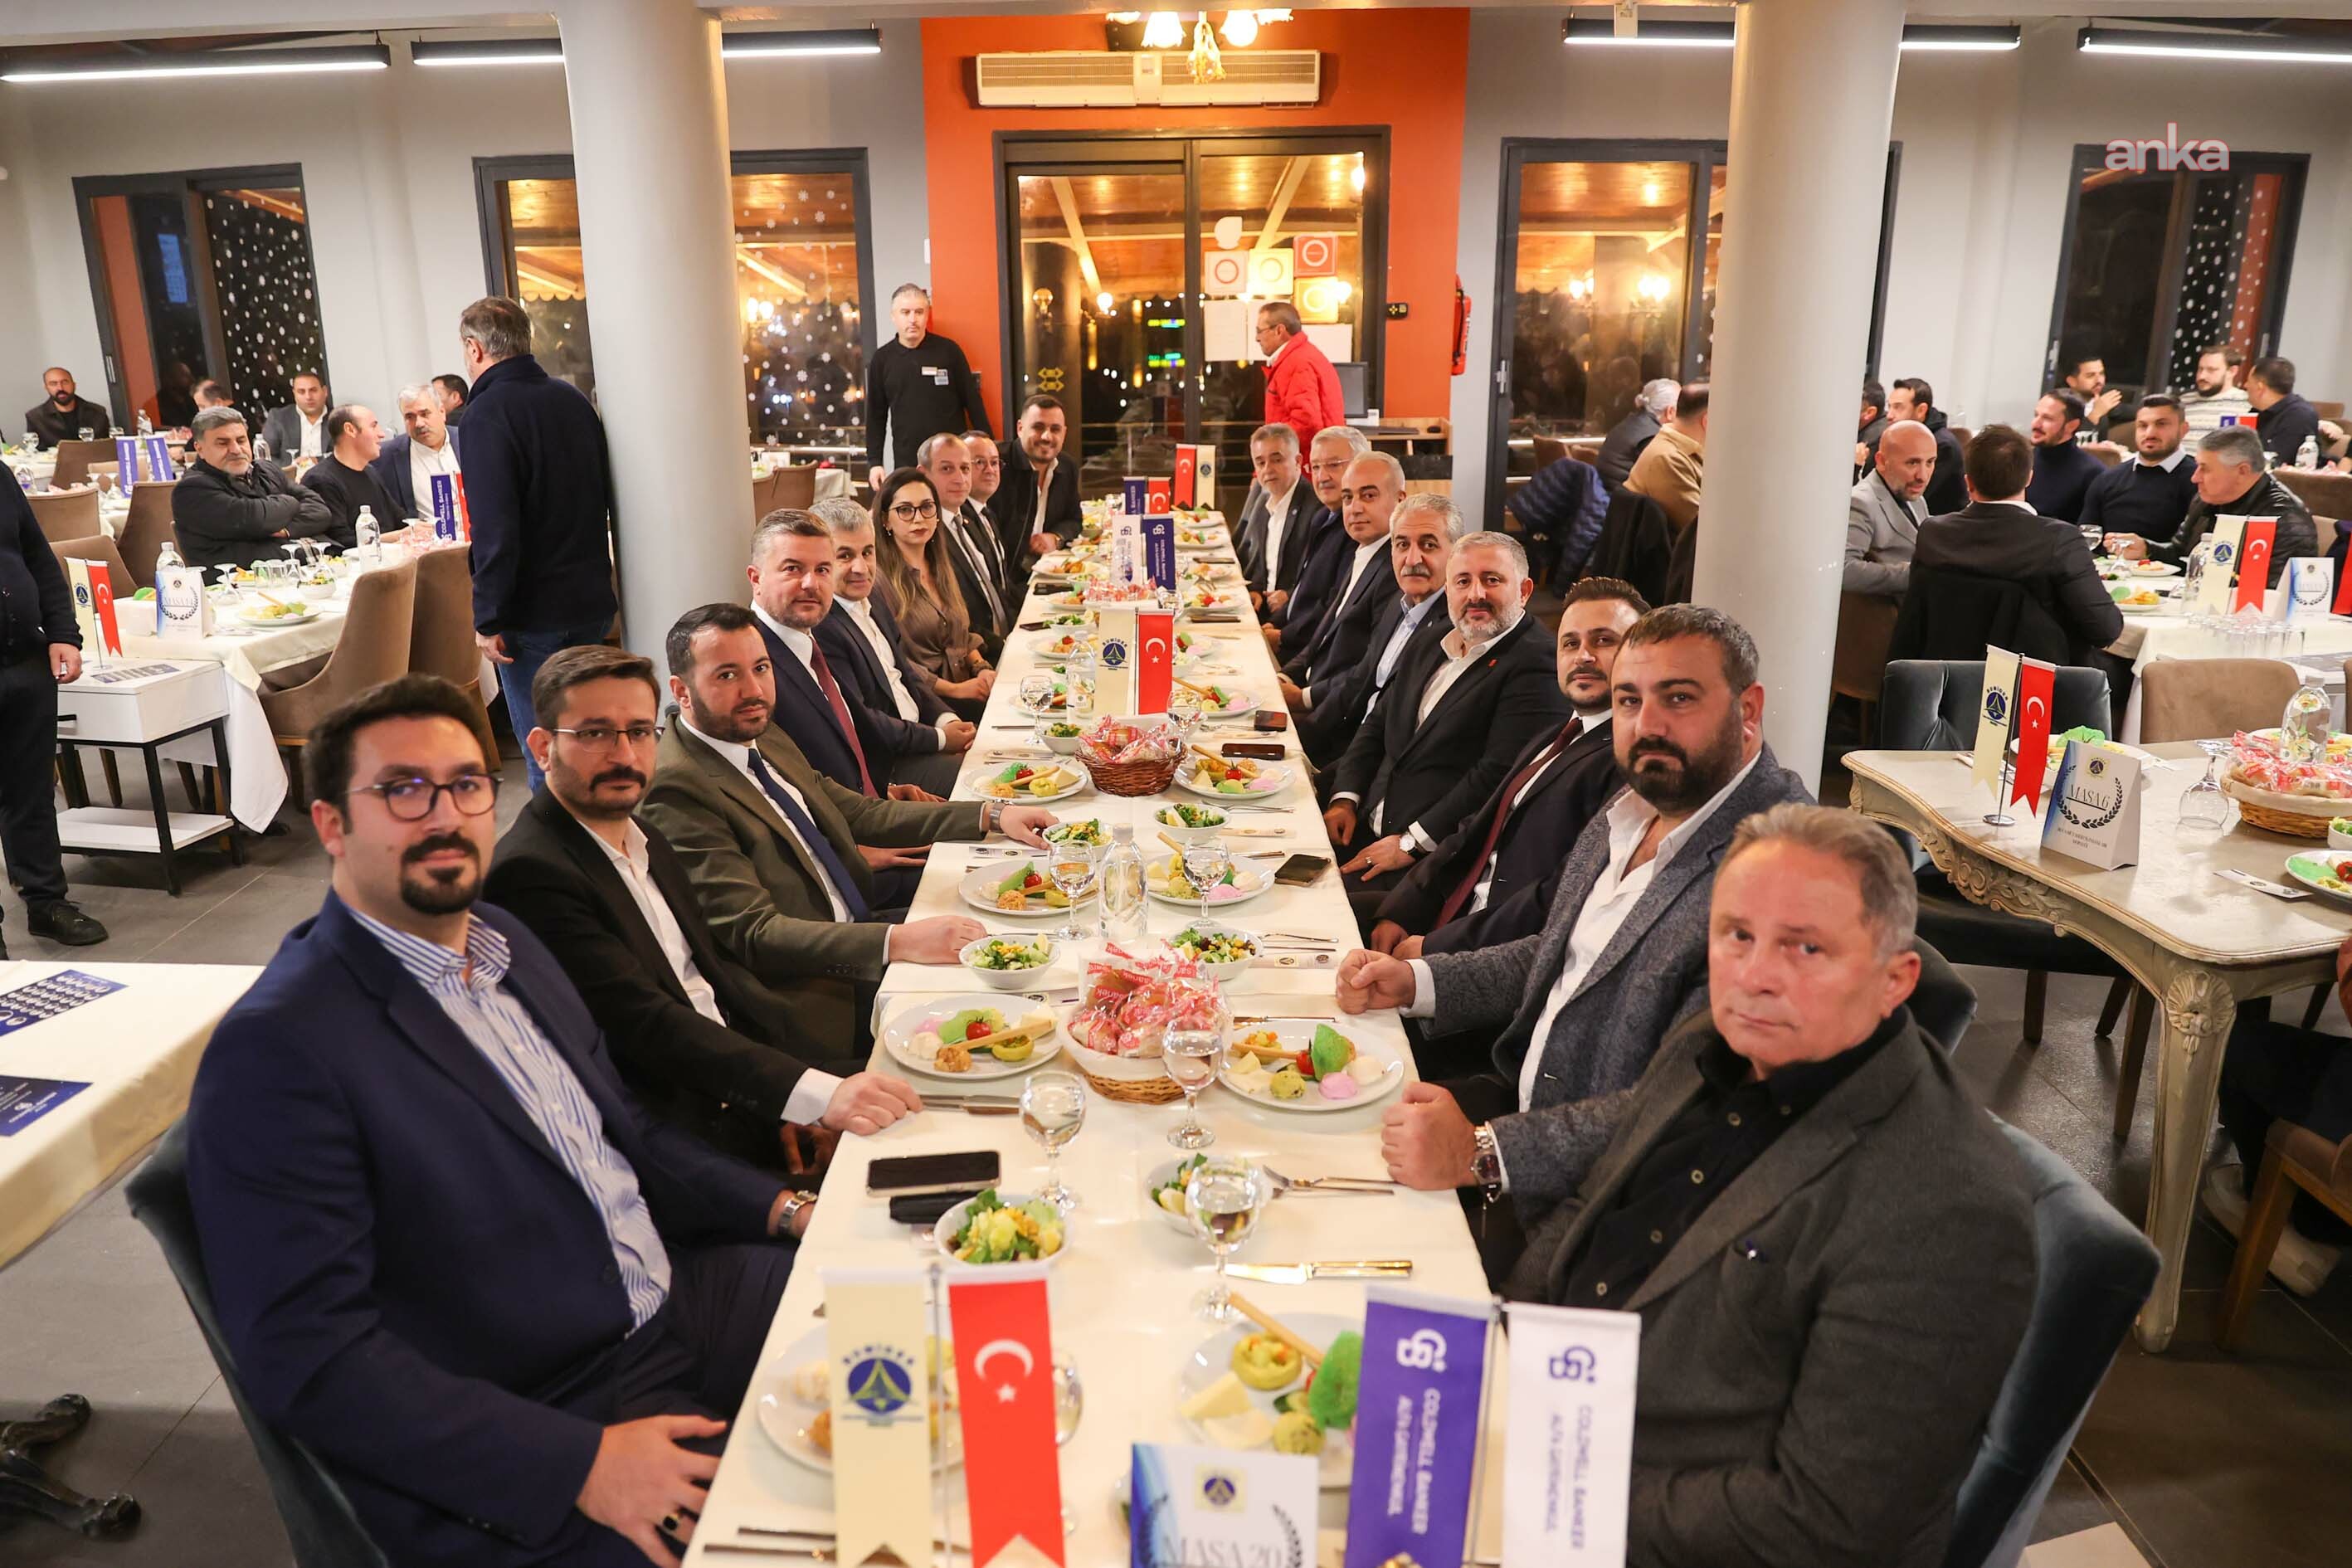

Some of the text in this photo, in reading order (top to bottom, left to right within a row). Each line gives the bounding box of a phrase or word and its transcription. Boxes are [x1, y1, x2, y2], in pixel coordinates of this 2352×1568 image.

[2068, 784, 2100, 806] MASA
[1412, 1387, 1441, 1535] COLDWELL BANKER
[1570, 1405, 1593, 1549] COLDWELL BANKER
[1162, 1536, 1244, 1568] MASA
